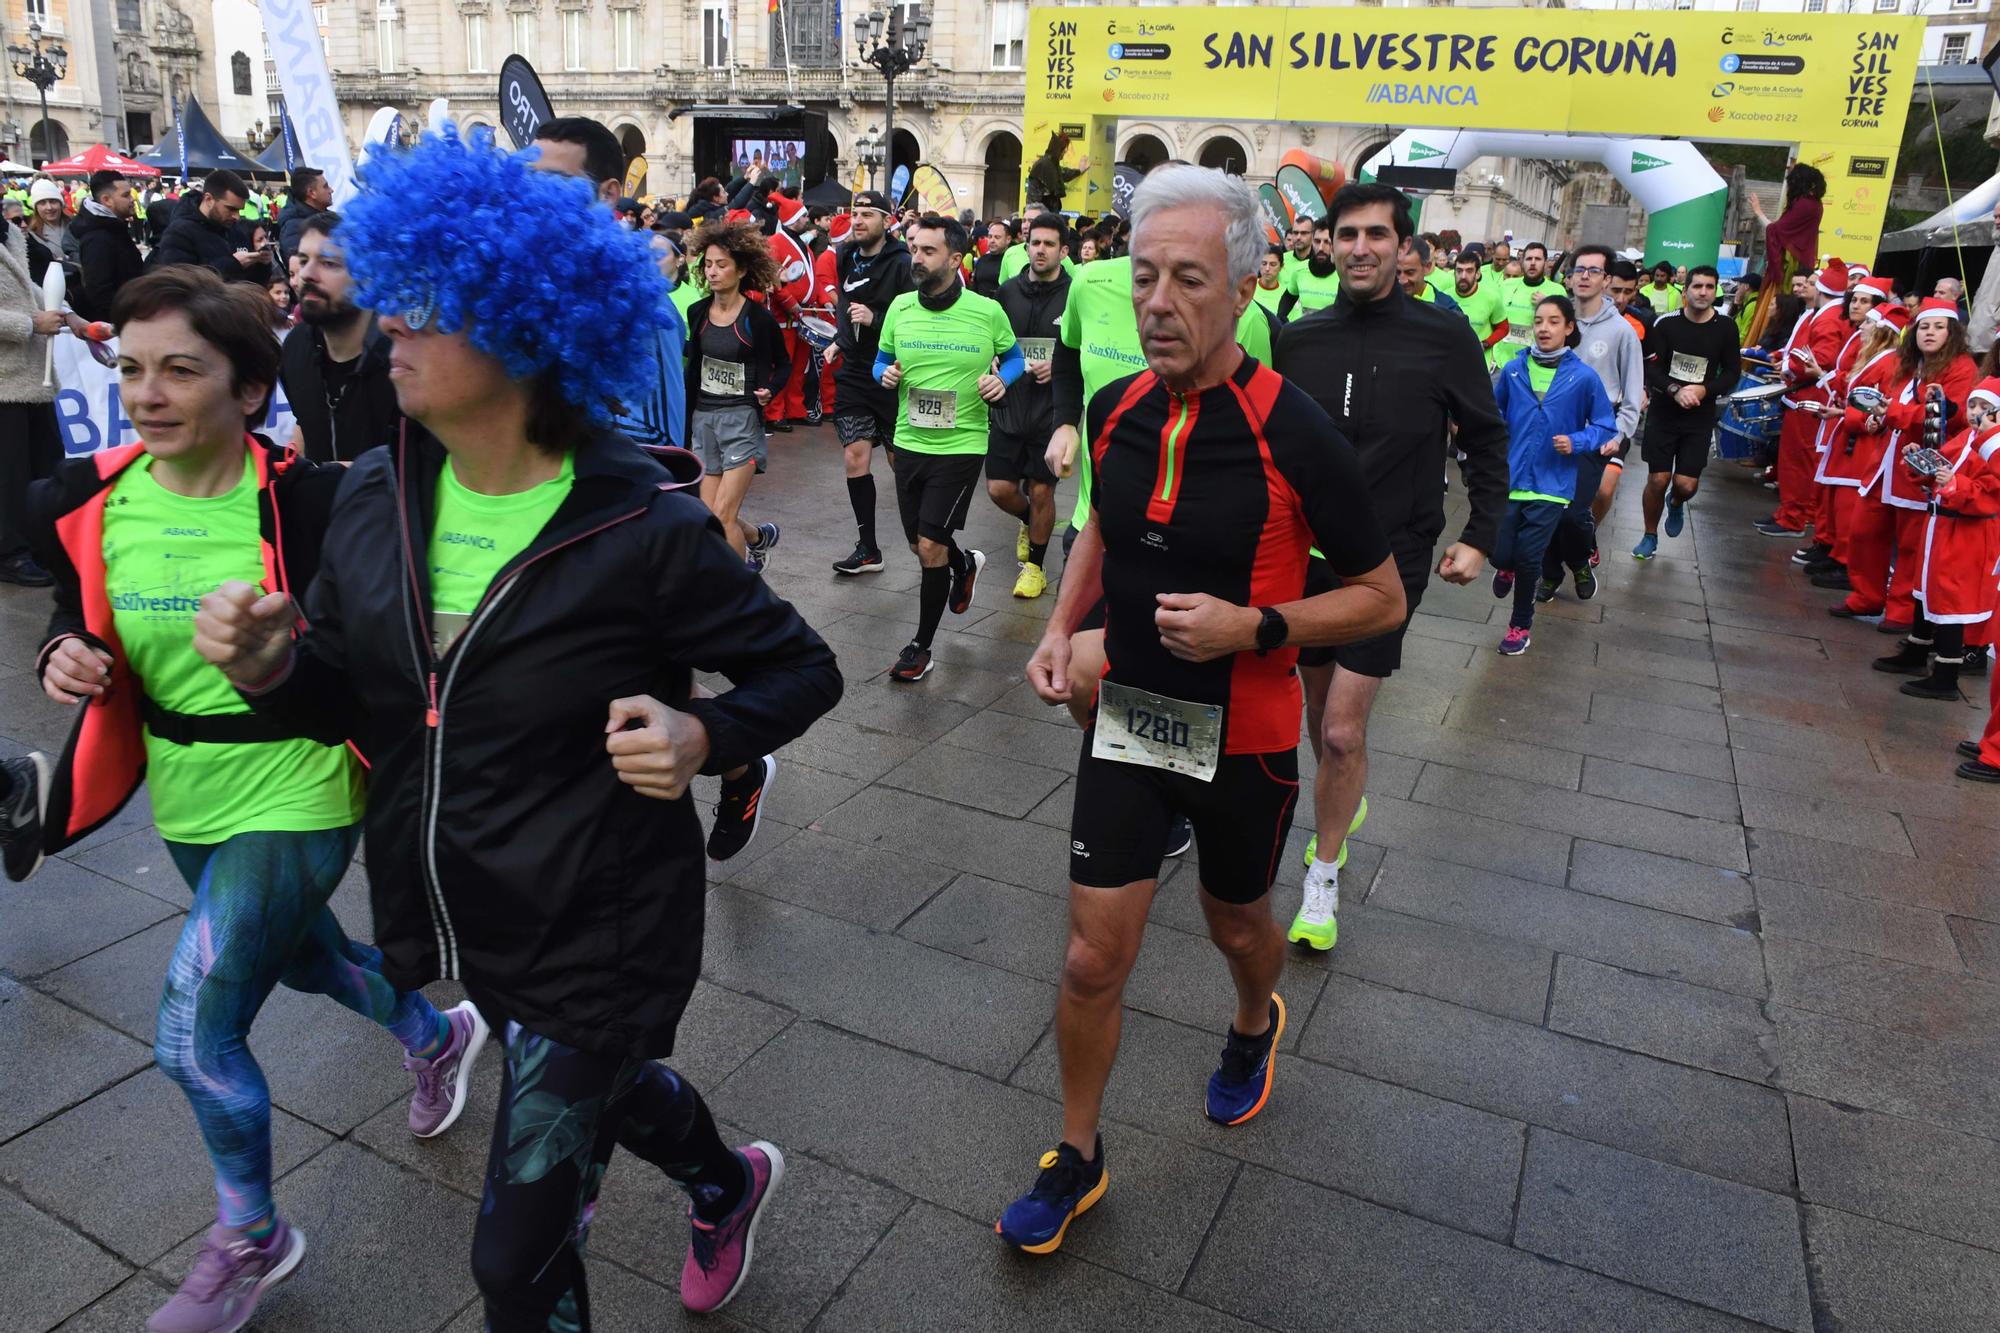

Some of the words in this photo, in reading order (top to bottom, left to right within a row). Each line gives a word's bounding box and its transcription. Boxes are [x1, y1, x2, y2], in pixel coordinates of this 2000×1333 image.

[1049, 21, 1077, 37] SAN
[1048, 38, 1076, 56] SIL
[1857, 32, 1899, 51] SAN
[1203, 31, 1274, 69] SAN
[1290, 32, 1498, 72] SILVESTRE
[1514, 32, 1676, 78] CORUÑA
[1047, 57, 1075, 73] VES
[1853, 53, 1892, 74] SIL
[1047, 74, 1074, 90] TRE
[1739, 84, 1761, 92] Puerto
[1849, 75, 1888, 96] VES
[1046, 92, 1071, 100] CORUÑA
[1118, 92, 1151, 100] Xacobeo
[1845, 96, 1886, 116] TRE
[1729, 111, 1773, 121] Xacobeo
[1841, 118, 1879, 128] CORUÑA
[1855, 162, 1881, 170] CASTRO
[1023, 346, 1047, 360] 1458
[1680, 361, 1698, 374] 1981
[708, 367, 736, 386] 3436
[918, 399, 942, 416] 829
[1127, 707, 1188, 747] 1280
